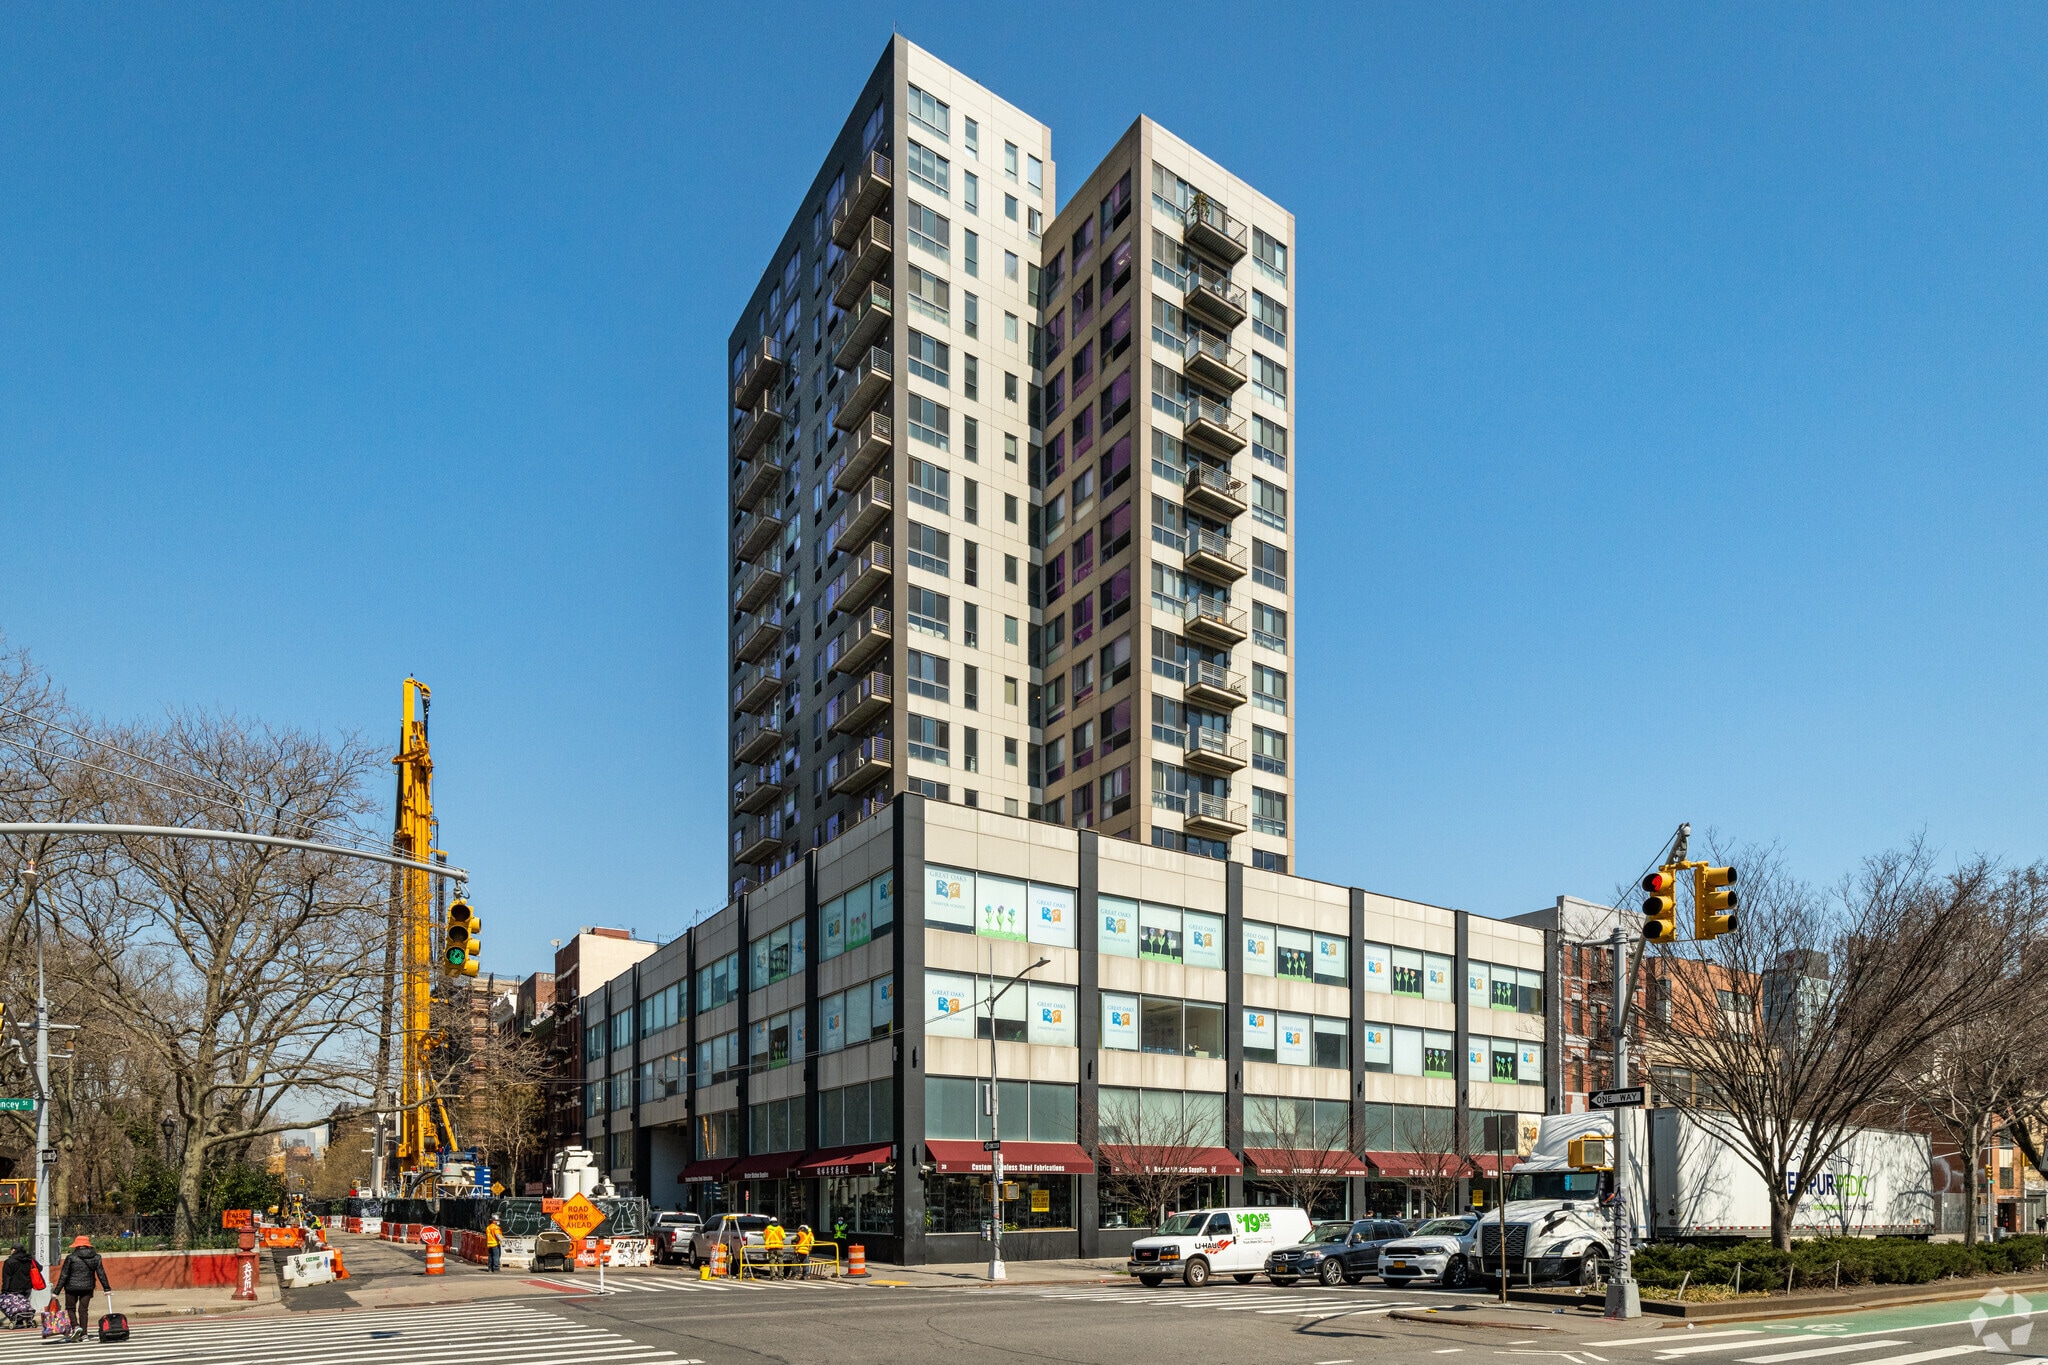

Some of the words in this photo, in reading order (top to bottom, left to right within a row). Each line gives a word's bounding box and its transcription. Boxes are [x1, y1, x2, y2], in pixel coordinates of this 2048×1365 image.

[929, 870, 949, 880] GREAT
[950, 874, 967, 882] OAKS
[1036, 899, 1052, 907] GREAT
[1100, 908, 1117, 916] GREAT
[1188, 923, 1203, 931] GREAT
[931, 989, 949, 998] GREAT
[1596, 1095, 1612, 1104] ONE
[1620, 1093, 1637, 1101] WAY
[0, 1101, 19, 1110] ncey
[971, 1163, 992, 1171] Custom
[1034, 1164, 1065, 1172] Fabrications
[422, 1231, 439, 1240] STOP
[1195, 1242, 1221, 1250] U-HAUL
